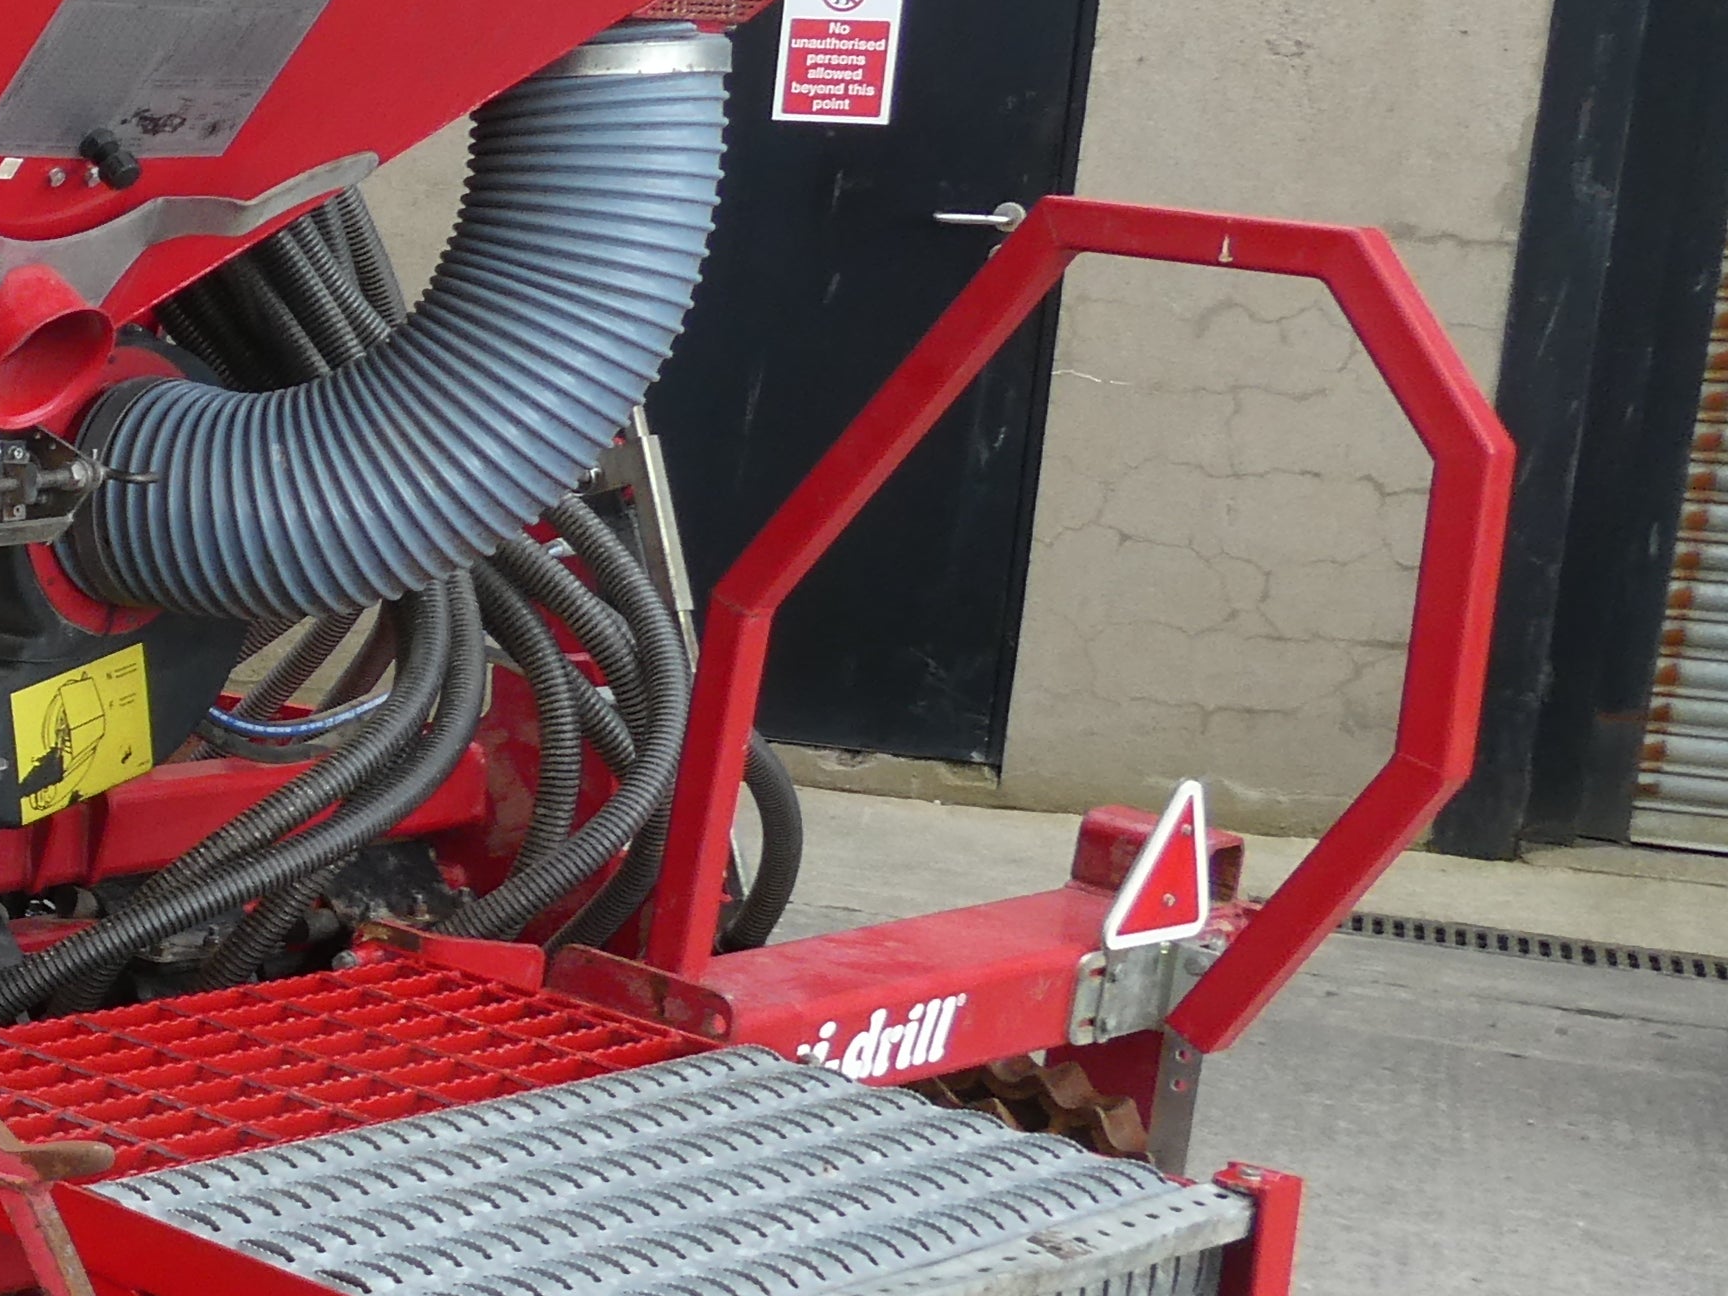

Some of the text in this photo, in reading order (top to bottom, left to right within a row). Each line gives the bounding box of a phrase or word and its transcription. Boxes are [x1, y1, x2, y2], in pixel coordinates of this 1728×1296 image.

[828, 22, 850, 35] No
[790, 37, 886, 51] unauthorised
[806, 53, 866, 66] persons
[807, 67, 863, 80] allowed
[790, 81, 876, 96] beyond this
[812, 97, 850, 112] point
